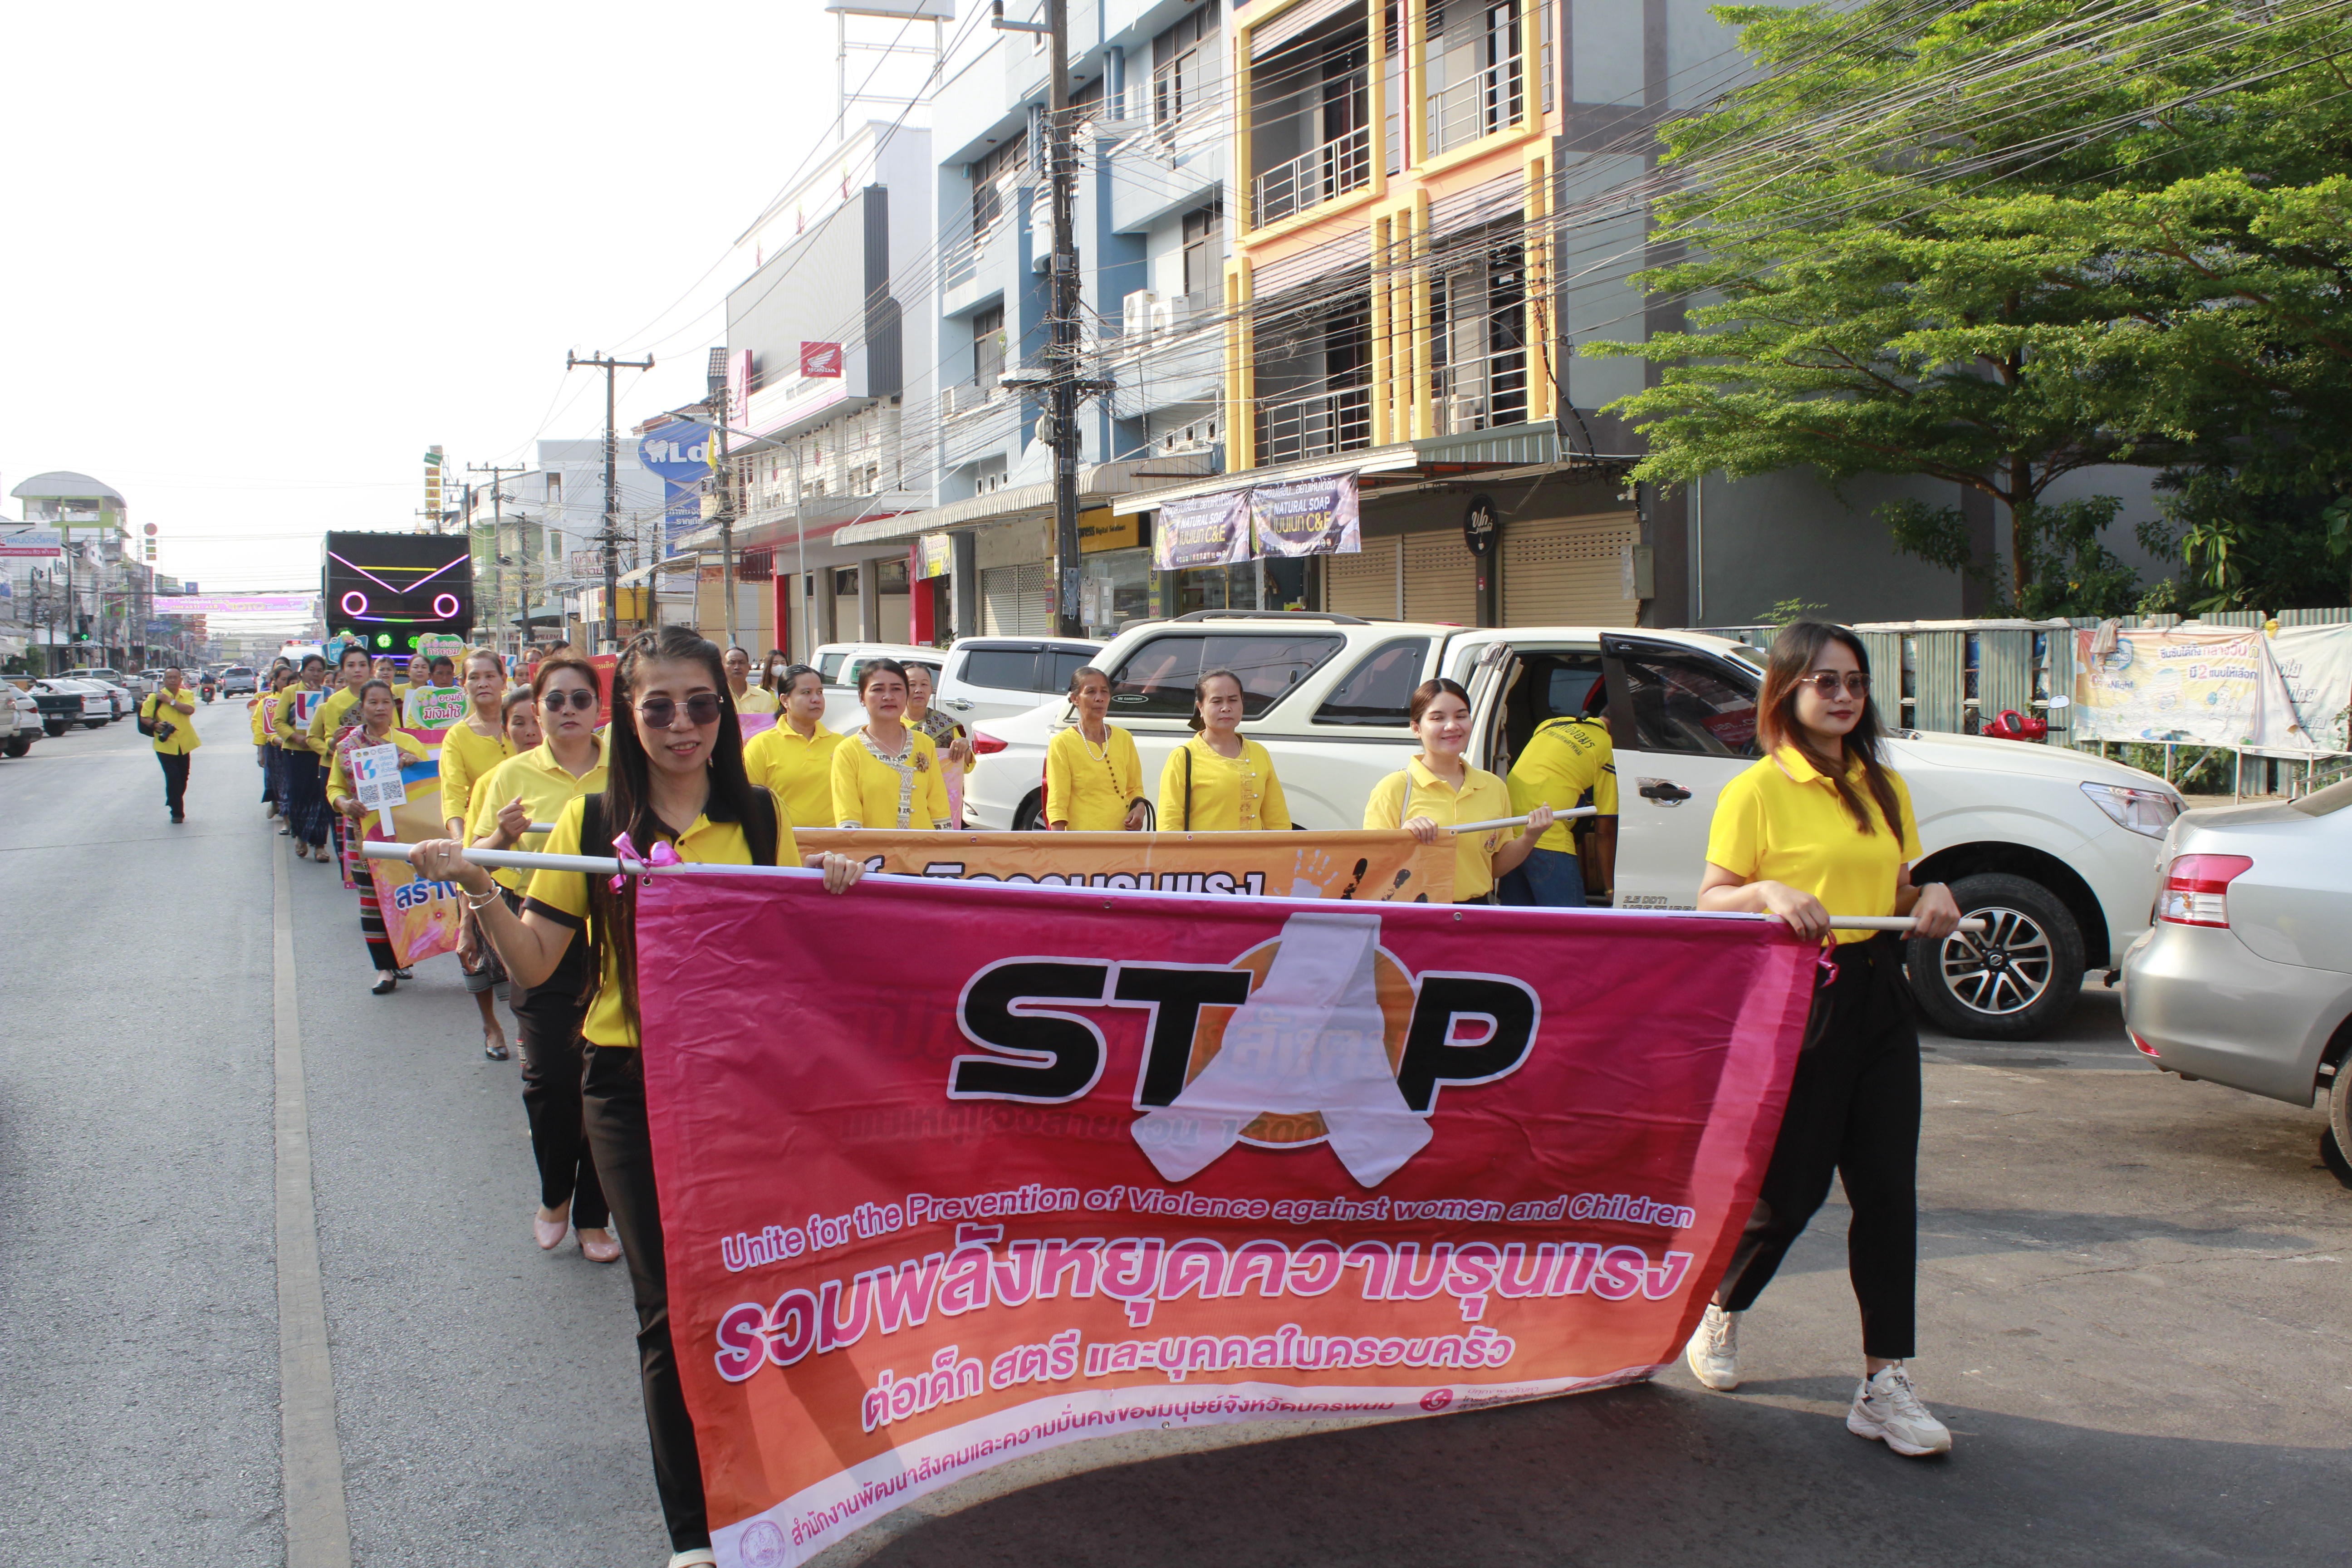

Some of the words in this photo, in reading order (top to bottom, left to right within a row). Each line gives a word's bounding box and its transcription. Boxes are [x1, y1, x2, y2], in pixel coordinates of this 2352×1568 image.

[1274, 500, 1307, 515] NATURAL
[1308, 495, 1331, 511] SOAP
[676, 516, 702, 525] รากเทีย
[1181, 514, 1209, 529] NATURAL
[1209, 510, 1227, 524] SOAP
[1306, 511, 1332, 533] C&E
[1096, 526, 1108, 535] Digital
[1205, 524, 1226, 543] C&E
[2190, 666, 2197, 678] มี
[2199, 665, 2207, 679] 2
[439, 692, 463, 702] ออมดี
[424, 704, 462, 720] มีเงินใช้
[722, 1225, 805, 1272] Unite
[808, 1214, 851, 1252] for
[855, 1201, 903, 1240] the
[906, 1184, 1079, 1227] Prevention
[1083, 1185, 1124, 1211] of
[1128, 1186, 1270, 1220] Violence
[1272, 1192, 1391, 1225] against
[1392, 1199, 1503, 1222] women
[1510, 1195, 1566, 1221] and
[1568, 1193, 1696, 1229] Children
[714, 1224, 1695, 1382] รวมพลังหยุดความรุนแรง
[861, 1344, 983, 1433] ต่อเด็ก
[990, 1329, 1082, 1391] สตรี
[1085, 1323, 1515, 1382] และบุคคลในครอบครัว
[792, 1394, 1396, 1547] สำนักงานพัฒนาสังคมและความมั่นคงของมนุษย์จังหวัดนครพนม
